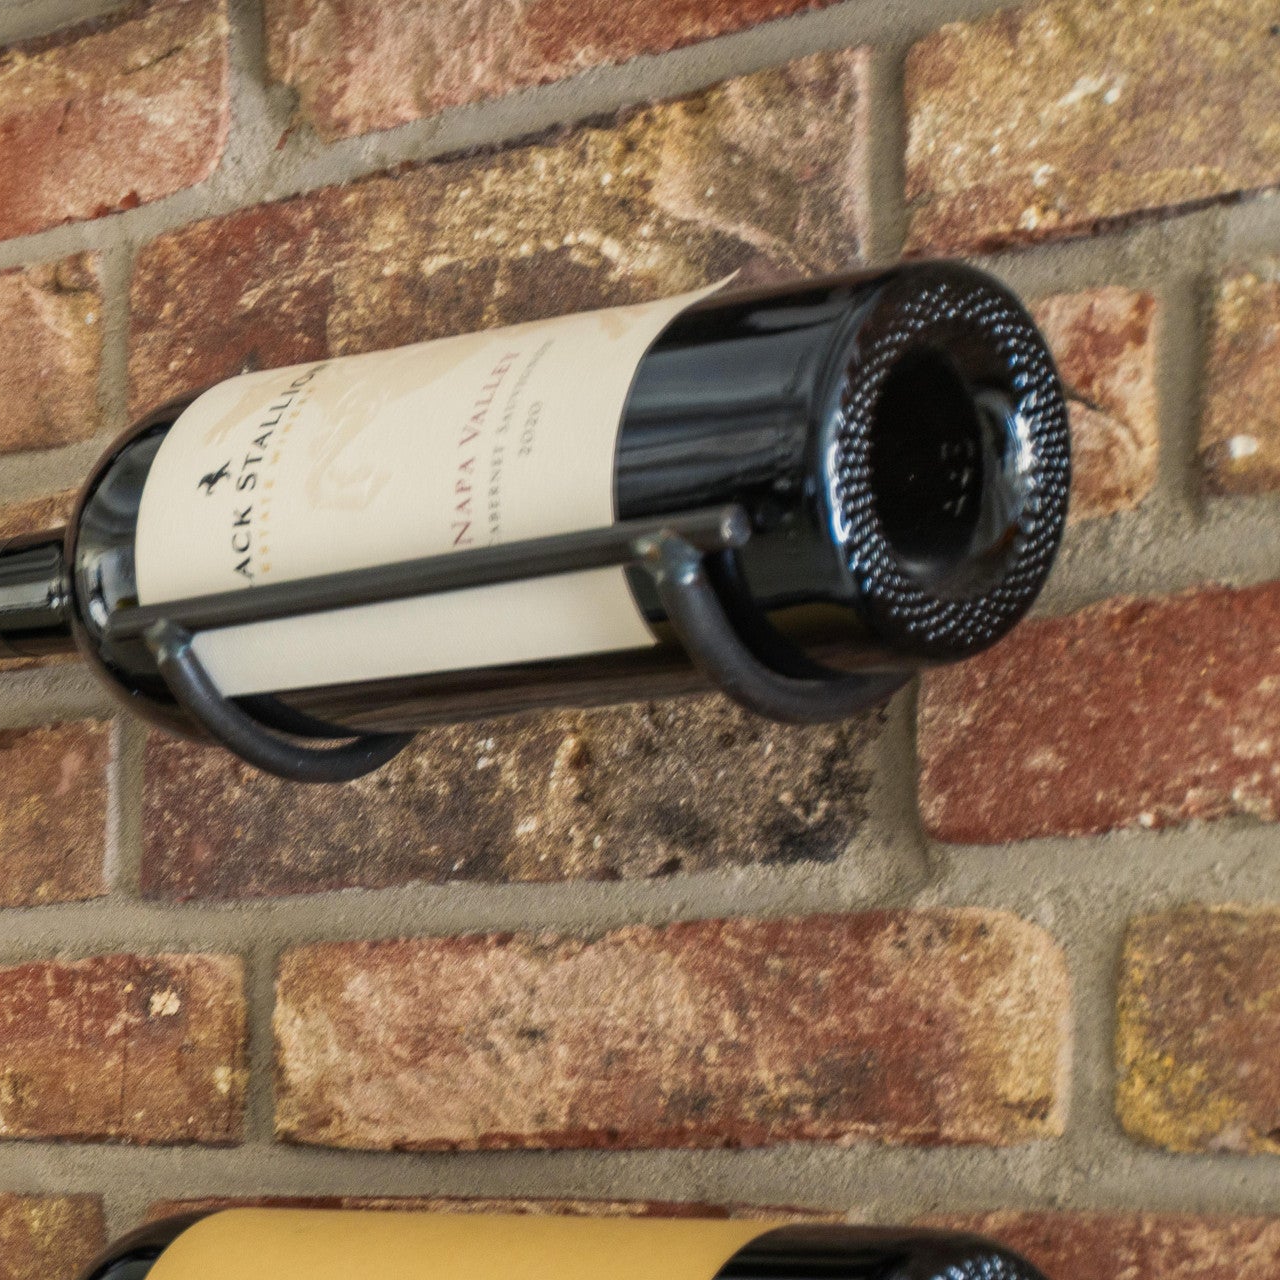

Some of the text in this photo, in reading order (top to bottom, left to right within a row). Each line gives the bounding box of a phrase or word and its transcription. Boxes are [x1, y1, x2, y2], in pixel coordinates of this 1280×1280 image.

[451, 351, 520, 546] NAPA VALLEY
[488, 446, 504, 543] ABERNET
[232, 505, 254, 587] ACK
